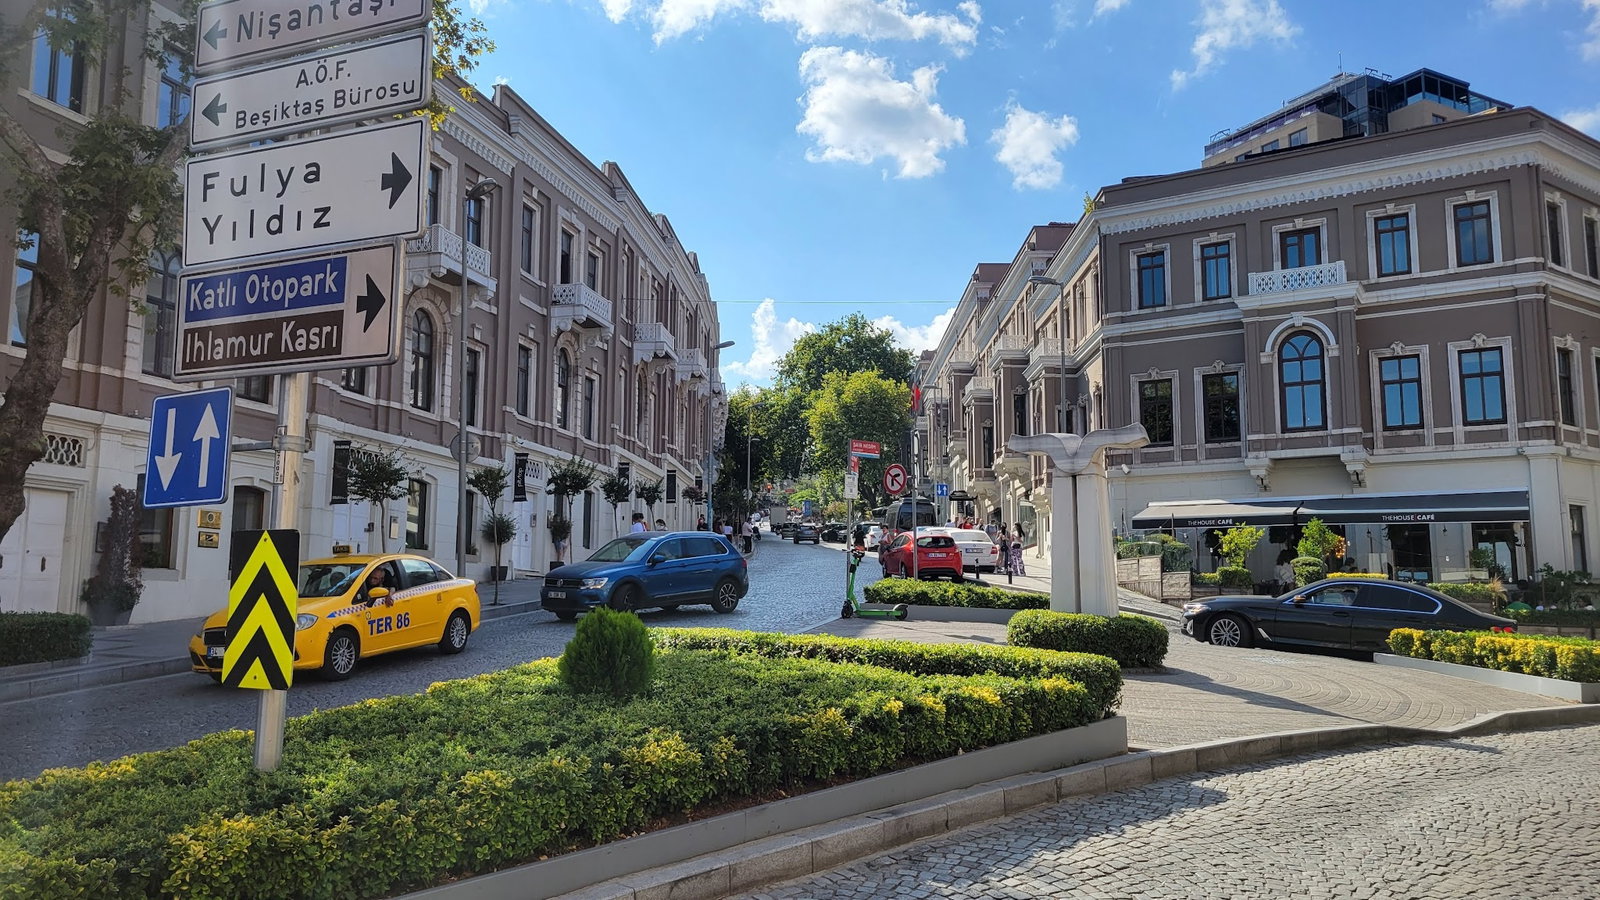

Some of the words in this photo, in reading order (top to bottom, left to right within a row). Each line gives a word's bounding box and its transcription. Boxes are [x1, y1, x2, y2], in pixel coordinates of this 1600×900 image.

[295, 59, 351, 89] A.Ö.F.
[235, 97, 324, 129] Beşiktaş
[333, 79, 415, 108] Bürosu
[202, 161, 321, 202] Fulya
[201, 204, 331, 245] Yıldız
[189, 278, 237, 312] Katlı
[245, 263, 339, 308] Otopark
[185, 330, 274, 363] Ihlamur
[280, 320, 338, 353] Kasrı
[367, 616, 393, 636] TER
[396, 611, 410, 629] 86
